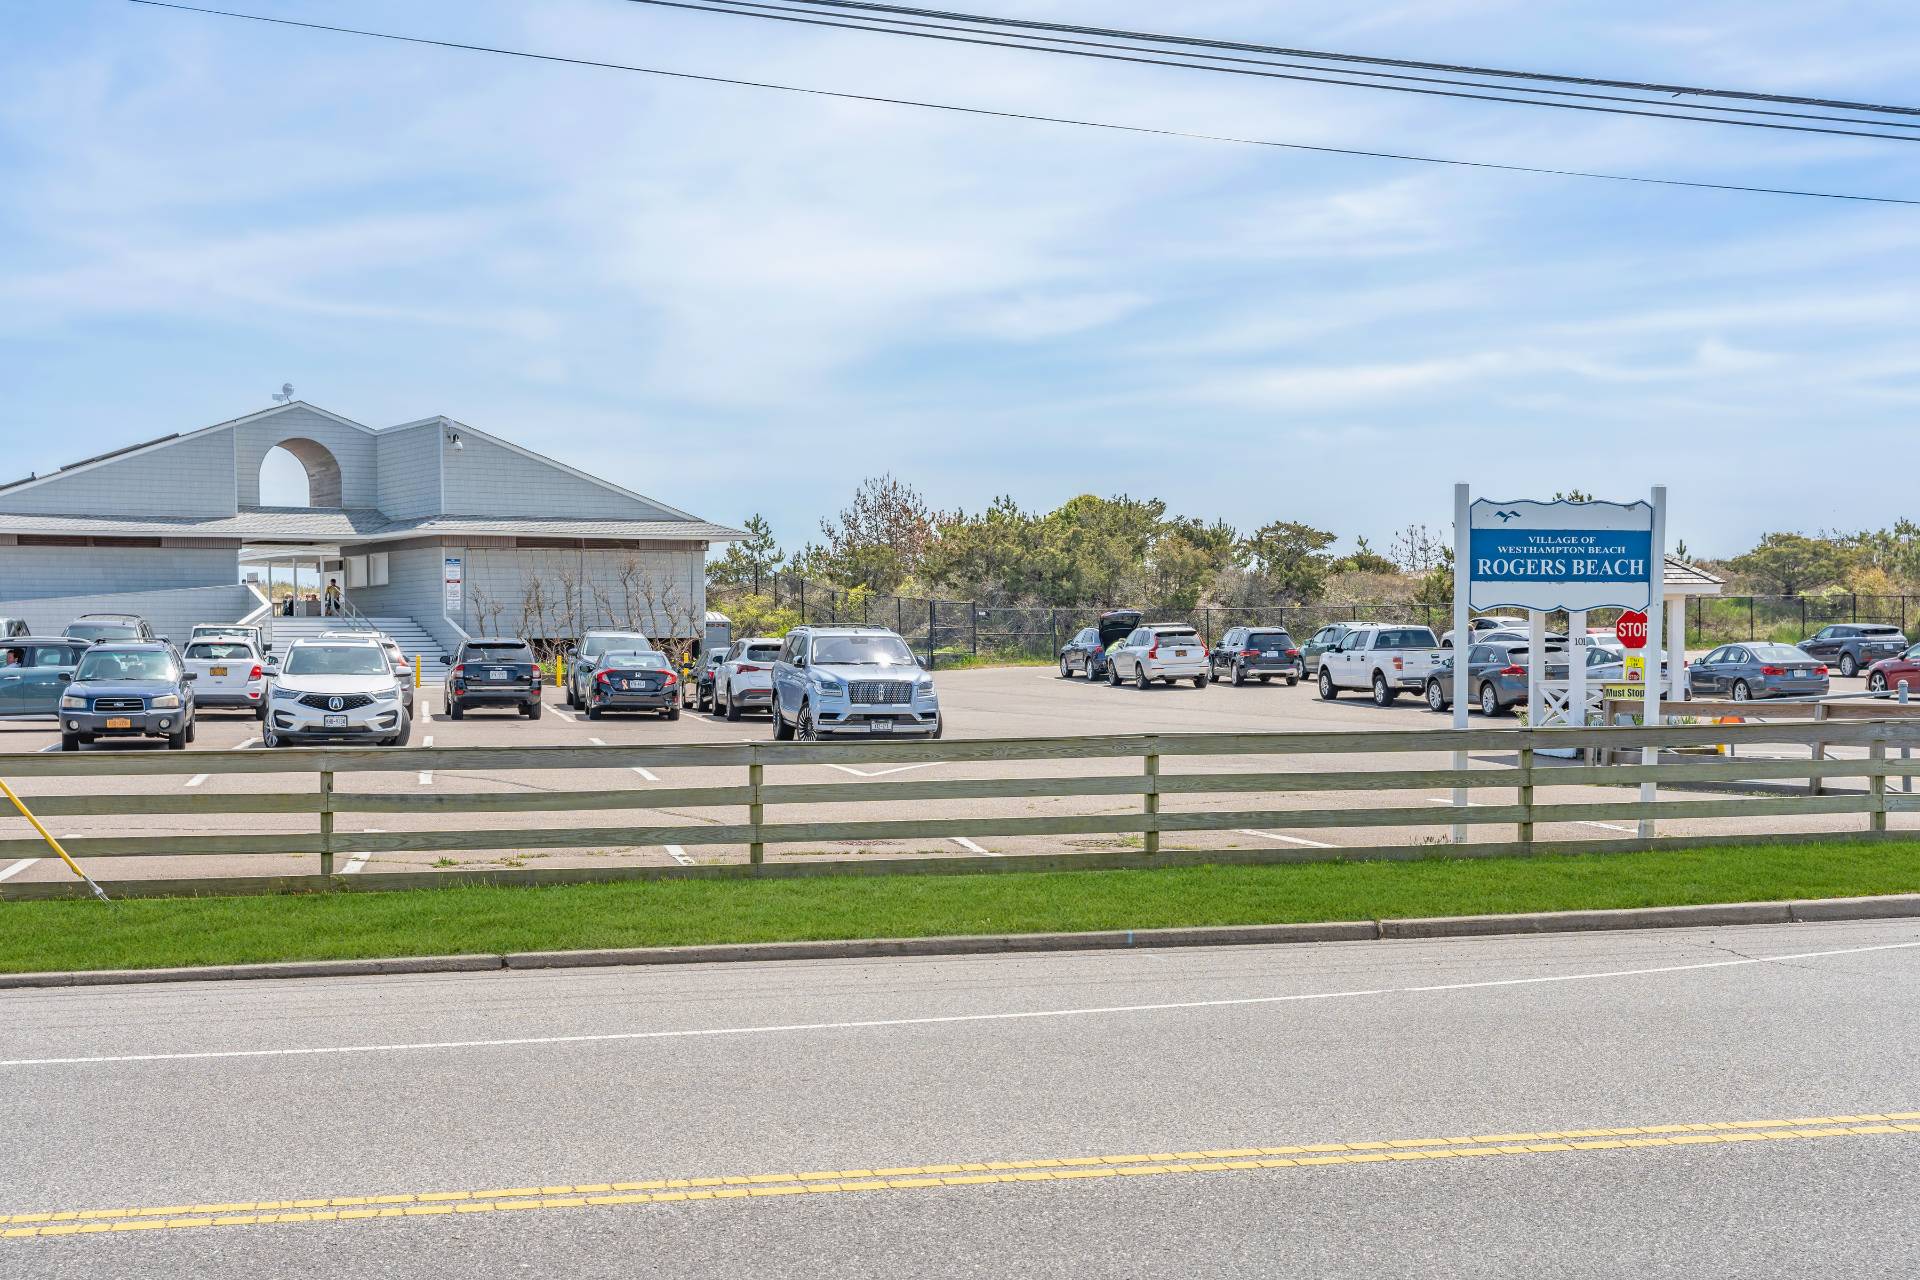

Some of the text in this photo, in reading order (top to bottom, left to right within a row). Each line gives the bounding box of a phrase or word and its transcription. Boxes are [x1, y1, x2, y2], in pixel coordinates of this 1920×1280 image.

[1528, 536, 1597, 544] VILLAGE OF
[1497, 546, 1626, 554] WESTHAMPTON BEACH
[1477, 558, 1645, 576] ROGERS BEACH
[1606, 688, 1625, 697] Must
